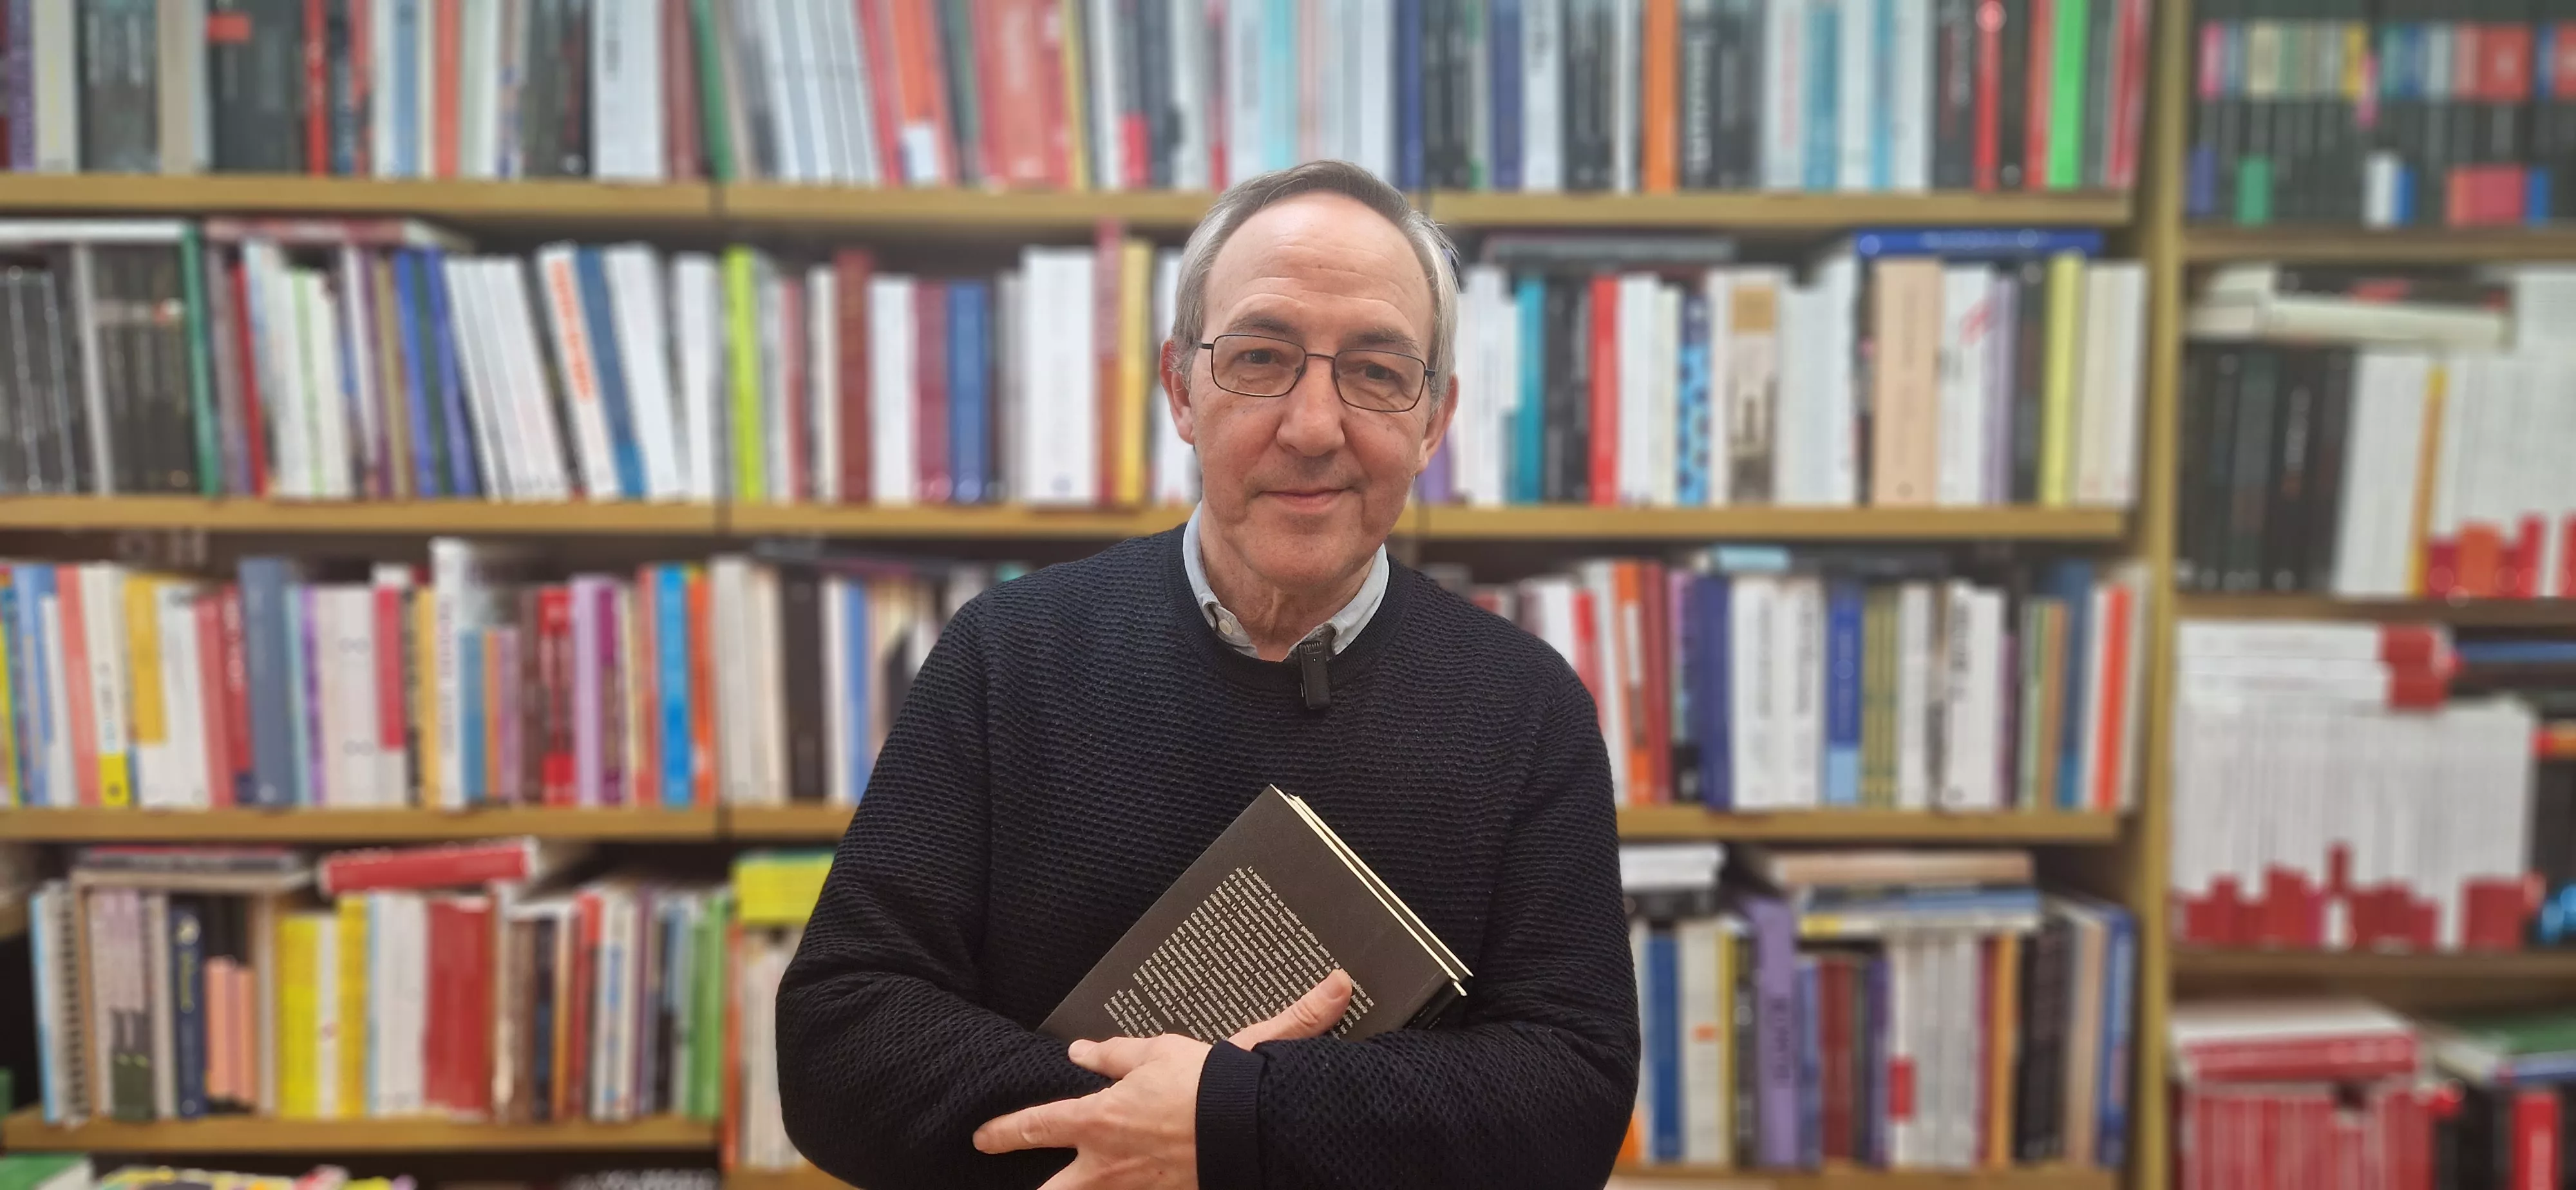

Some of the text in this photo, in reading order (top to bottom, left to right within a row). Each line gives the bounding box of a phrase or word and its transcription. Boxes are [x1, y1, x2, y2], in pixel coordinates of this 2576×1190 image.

[1179, 941, 1198, 965] Apoyados
[1195, 963, 1206, 972] por
[1204, 970, 1210, 978] la
[1182, 919, 1201, 940] posesión
[1198, 938, 1209, 947] del
[1205, 945, 1227, 969] misterioso
[1224, 967, 1242, 987] Archivo
[1189, 911, 1202, 925] Cabo
[1199, 923, 1207, 932] de
[1215, 941, 1225, 952] que
[1222, 950, 1234, 963] muy
[1231, 960, 1244, 974] claro
[1241, 972, 1249, 981] no
[1247, 978, 1254, 986] lo
[1267, 1000, 1276, 1010] De
[1196, 905, 1214, 926] corrupto
[1212, 924, 1222, 934] del
[1219, 931, 1235, 950] Partido
[1233, 947, 1255, 973] Ecologista
[1273, 992, 1282, 1003] del
[1202, 899, 1216, 914] micos
[1213, 912, 1221, 920] de
[1218, 918, 1231, 932] unos
[1256, 959, 1267, 972] han
[1264, 970, 1289, 997] colisionado
[1220, 906, 1228, 914] en
[1231, 917, 1245, 934] centro
[1243, 932, 1251, 940] de
[1249, 938, 1259, 949] una
[1256, 947, 1276, 968] delirante
[1274, 966, 1289, 983] trama
[1287, 980, 1302, 997] donde
[1226, 885, 1236, 896] pos
[1234, 893, 1242, 902] de
[1239, 898, 1246, 907] la
[1243, 904, 1262, 923] peculiar
[1259, 920, 1278, 942] herencia
[1276, 940, 1292, 958] robada
[1293, 959, 1303, 970] una
[1301, 968, 1309, 977] no
[1230, 902, 1238, 911] La
[1236, 908, 1250, 925] huella
[1248, 923, 1258, 932] del
[1255, 931, 1270, 947] dinero
[1272, 949, 1285, 965] algún
[1283, 963, 1294, 974] que
[1292, 972, 1303, 985] otro
[1233, 878, 1242, 888] los
[1240, 885, 1262, 910] vibradores
[1279, 930, 1288, 939] un
[1300, 953, 1318, 972] periplo
[1314, 969, 1325, 979] por
[1234, 867, 1246, 879] shop
[1244, 876, 1262, 897] conduce
[1263, 898, 1278, 914] Ajonio
[1298, 938, 1326, 967] protagonista
[1350, 994, 1368, 1014] historia
[1246, 865, 1254, 874] La
[1251, 872, 1272, 894] aparición
[1270, 892, 1278, 900] de
[1276, 898, 1285, 907] un
[1315, 943, 1331, 958] junto
[1332, 961, 1340, 969] su
[1138, 964, 1154, 984] historia
[1152, 982, 1160, 990] de
[1175, 1009, 1189, 1026] acción
[1142, 983, 1149, 992] la
[1146, 990, 1157, 1002] sota
[1155, 1000, 1162, 1008] de
[1144, 958, 1152, 967] de
[1179, 998, 1191, 1014] hasta
[1189, 1012, 1197, 1021] un
[1195, 1019, 1214, 1041] sacristán
[1151, 951, 1162, 965] ticos
[1160, 963, 1168, 972] sin
[1187, 994, 1195, 1003] un
[1193, 1001, 1213, 1025] sacerdote
[1157, 945, 1171, 961] tratan
[1169, 959, 1177, 967] de
[1174, 965, 1195, 988] sobrevivir
[1195, 990, 1206, 1002] una
[1203, 999, 1222, 1021] aventura
[1220, 1019, 1235, 1035] donde
[1168, 944, 1186, 965] damisela
[1184, 963, 1203, 984] dedicada
[1204, 987, 1218, 1002] oficio
[1215, 999, 1226, 1011] más
[1224, 1009, 1242, 1028] antiguo
[1200, 953, 1208, 961] de
[1210, 965, 1227, 984] pueden
[1225, 982, 1244, 1002] alcanzar
[1242, 999, 1248, 1008] la
